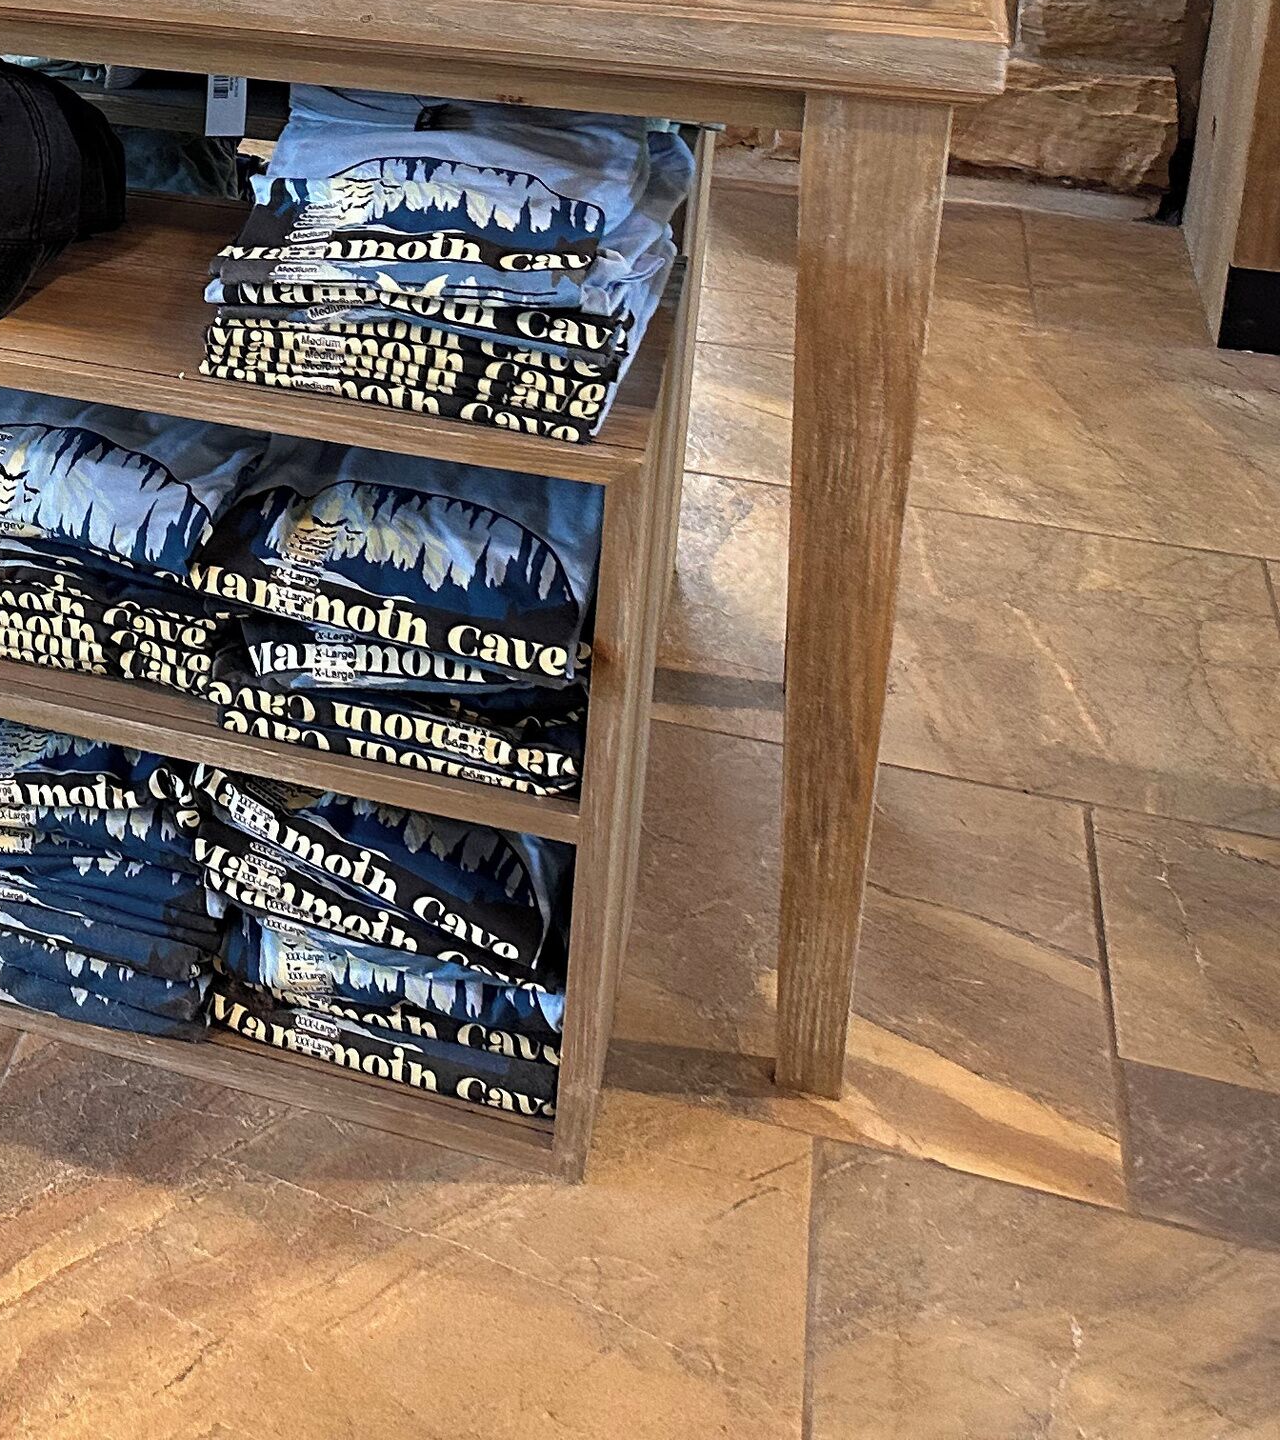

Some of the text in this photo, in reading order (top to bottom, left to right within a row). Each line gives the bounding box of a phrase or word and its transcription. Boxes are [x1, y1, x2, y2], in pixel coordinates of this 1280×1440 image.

[293, 229, 330, 241] Medium
[277, 265, 318, 274] Medium
[309, 302, 350, 318] Medium
[301, 335, 342, 348] Medium
[295, 379, 335, 392] Medium
[278, 568, 317, 584] X-Large
[276, 588, 314, 605] X-Large
[317, 631, 355, 641] X-Large
[315, 648, 354, 660] X-Large
[448, 624, 569, 679] Cave
[314, 668, 354, 680] X-Large
[286, 951, 325, 962] XXX-Large
[297, 1015, 338, 1036] XXX-Large
[294, 1035, 335, 1056] XXX-Large
